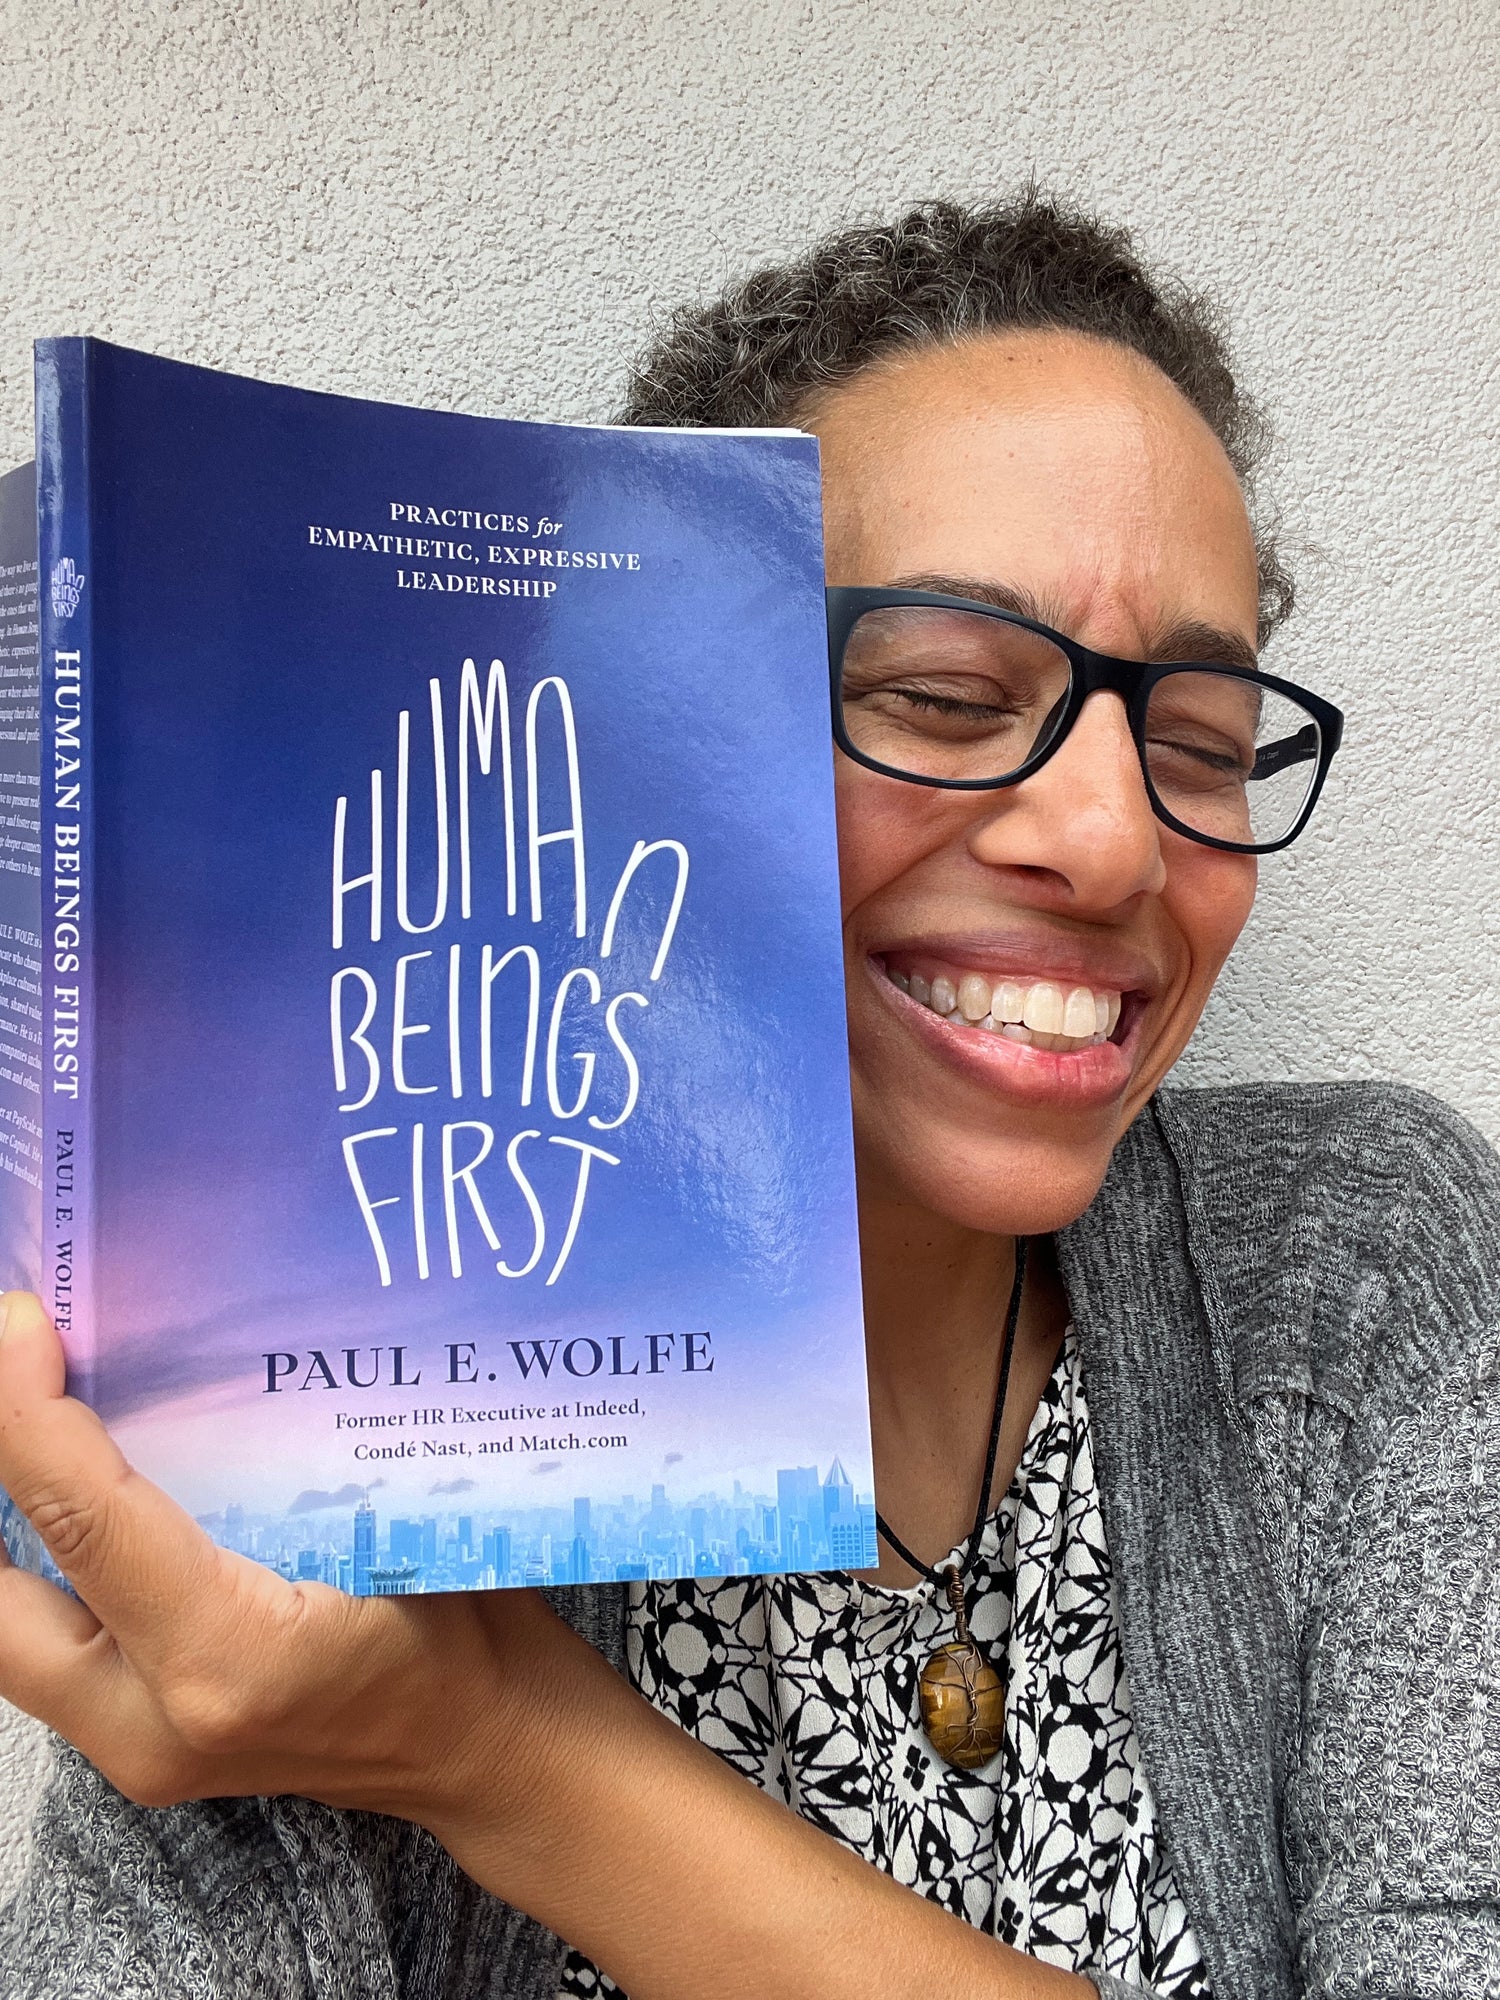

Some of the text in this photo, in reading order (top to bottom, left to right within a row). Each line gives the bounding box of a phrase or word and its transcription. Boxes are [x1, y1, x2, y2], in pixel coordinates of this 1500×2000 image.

[389, 502, 563, 538] PRACTICES for
[307, 525, 641, 571] EMPATHETIC, EXPRESSIVE
[396, 570, 557, 599] LEADERSHIP
[52, 601, 77, 618] FIRST
[53, 649, 81, 1099] HUMAN BEINGS FIRST
[342, 1121, 621, 1287] FIRST
[54, 1128, 74, 1332] PAUL E. WOLFE
[261, 1331, 716, 1394] PAUL E. WOLFE
[335, 1398, 647, 1431] Former HR Executive at Indeed,
[353, 1431, 628, 1461] Condé Nast, and Match.com
